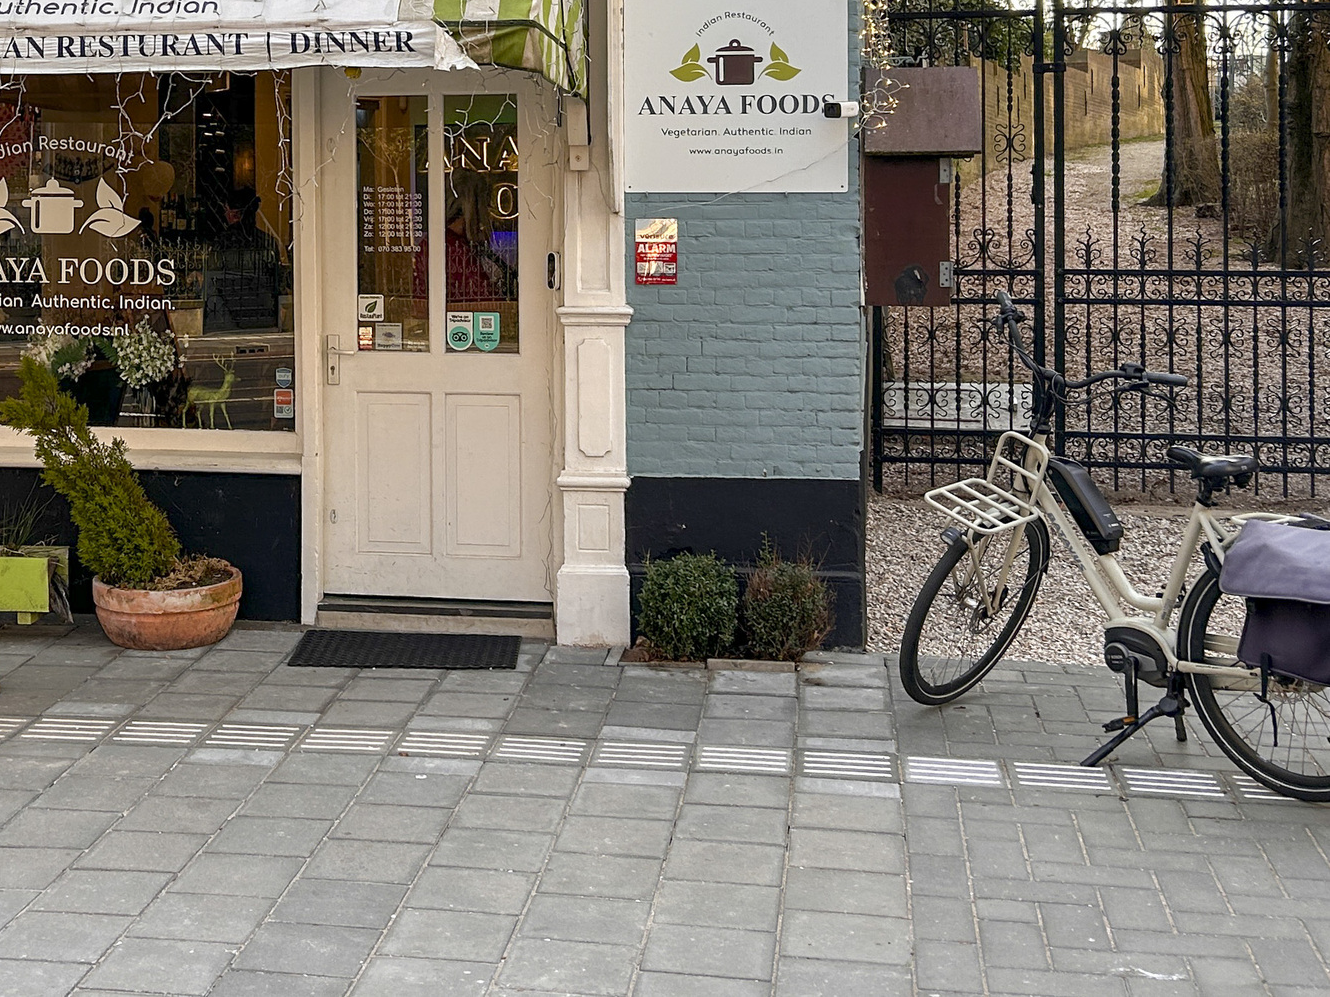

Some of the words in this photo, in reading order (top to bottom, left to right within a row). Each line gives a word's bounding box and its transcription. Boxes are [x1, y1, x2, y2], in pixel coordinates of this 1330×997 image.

[695, 15, 722, 37] Indian
[724, 11, 775, 36] Restaurant
[56, 33, 248, 59] RESTURANT
[289, 30, 416, 53] DINNER
[638, 95, 732, 115] ANAYA
[779, 127, 812, 136] Indian
[39, 136, 134, 165] Restaurant
[689, 146, 783, 156] www.anayafoods.in
[637, 243, 676, 253] ALARM
[57, 258, 175, 286] FOODS
[31, 293, 114, 309] Authentic.
[119, 295, 175, 311] Indian.
